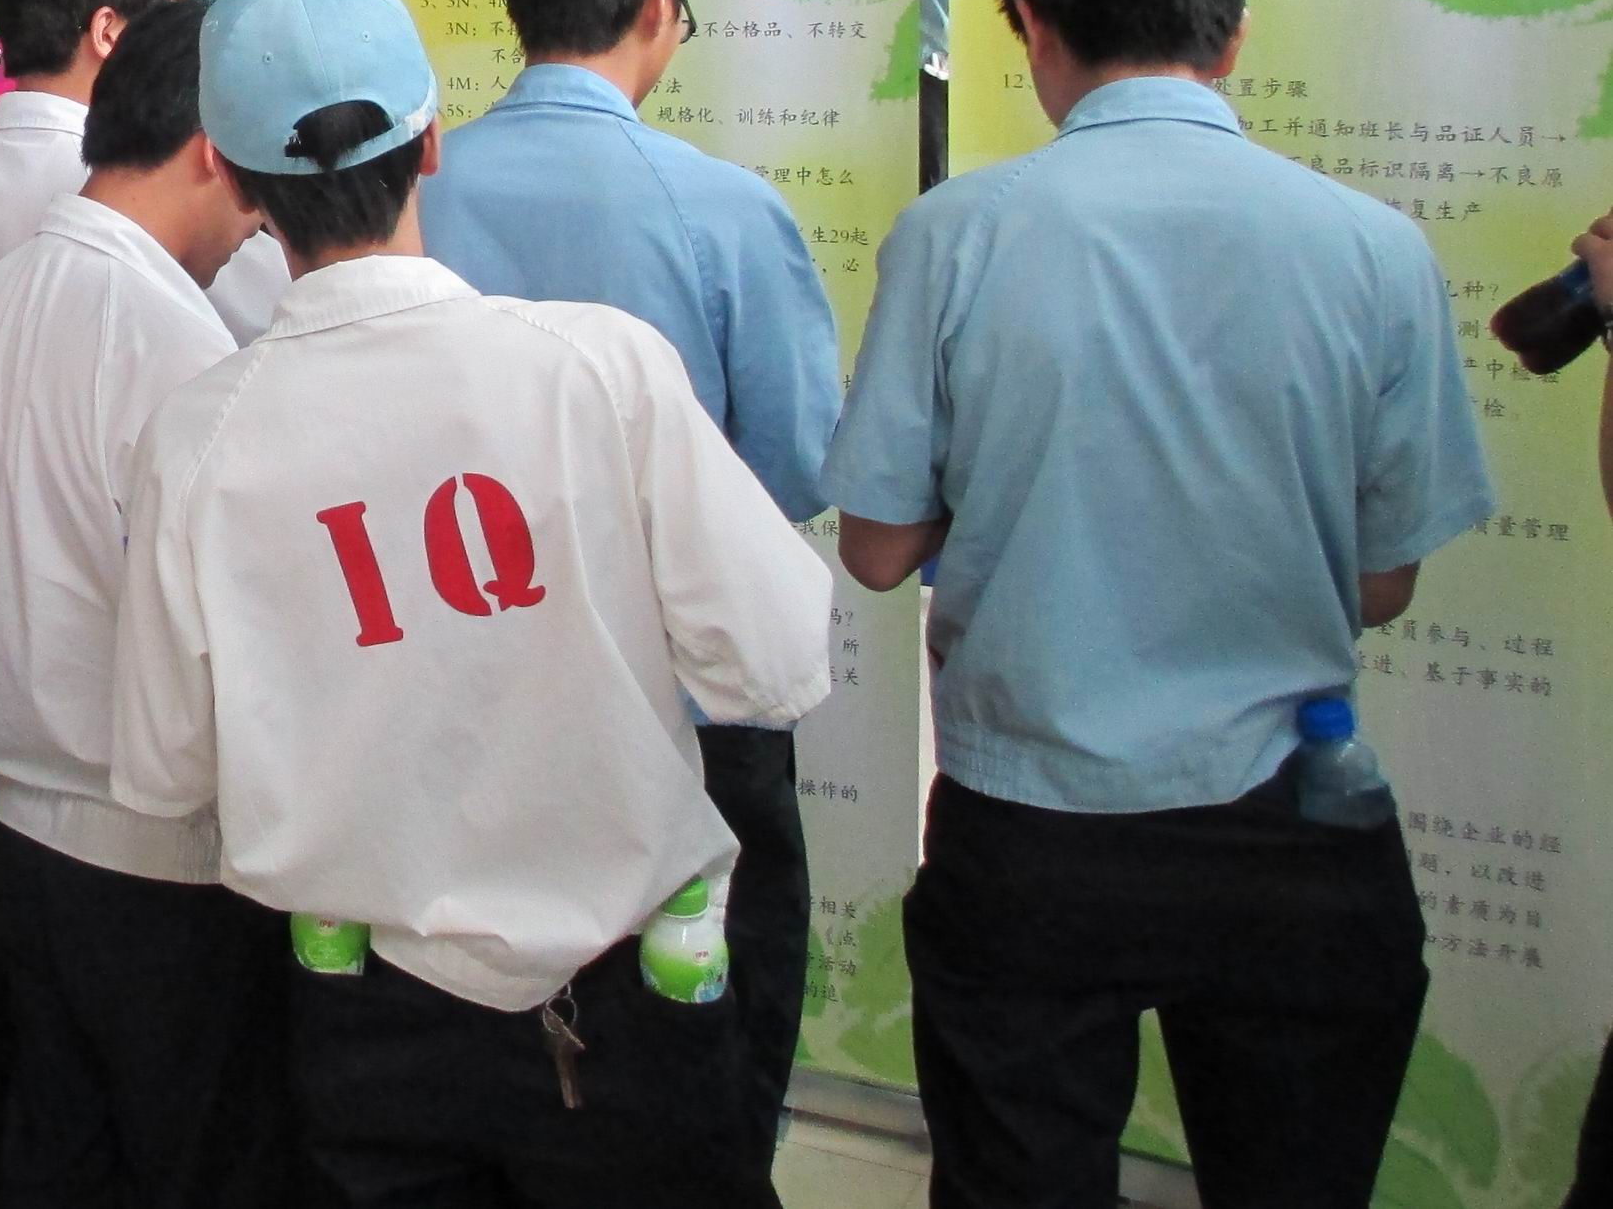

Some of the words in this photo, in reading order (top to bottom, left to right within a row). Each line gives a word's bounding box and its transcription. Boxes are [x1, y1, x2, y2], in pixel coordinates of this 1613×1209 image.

[690, 19, 868, 40] 不合格品、不转交
[1288, 154, 1455, 183] 良品标识隔离
[799, 224, 869, 246] 生29起
[791, 519, 839, 538] 我保
[315, 472, 546, 648] IQ
[797, 777, 859, 803] 操作的
[809, 894, 857, 919] 相关
[807, 950, 857, 977] 活动
